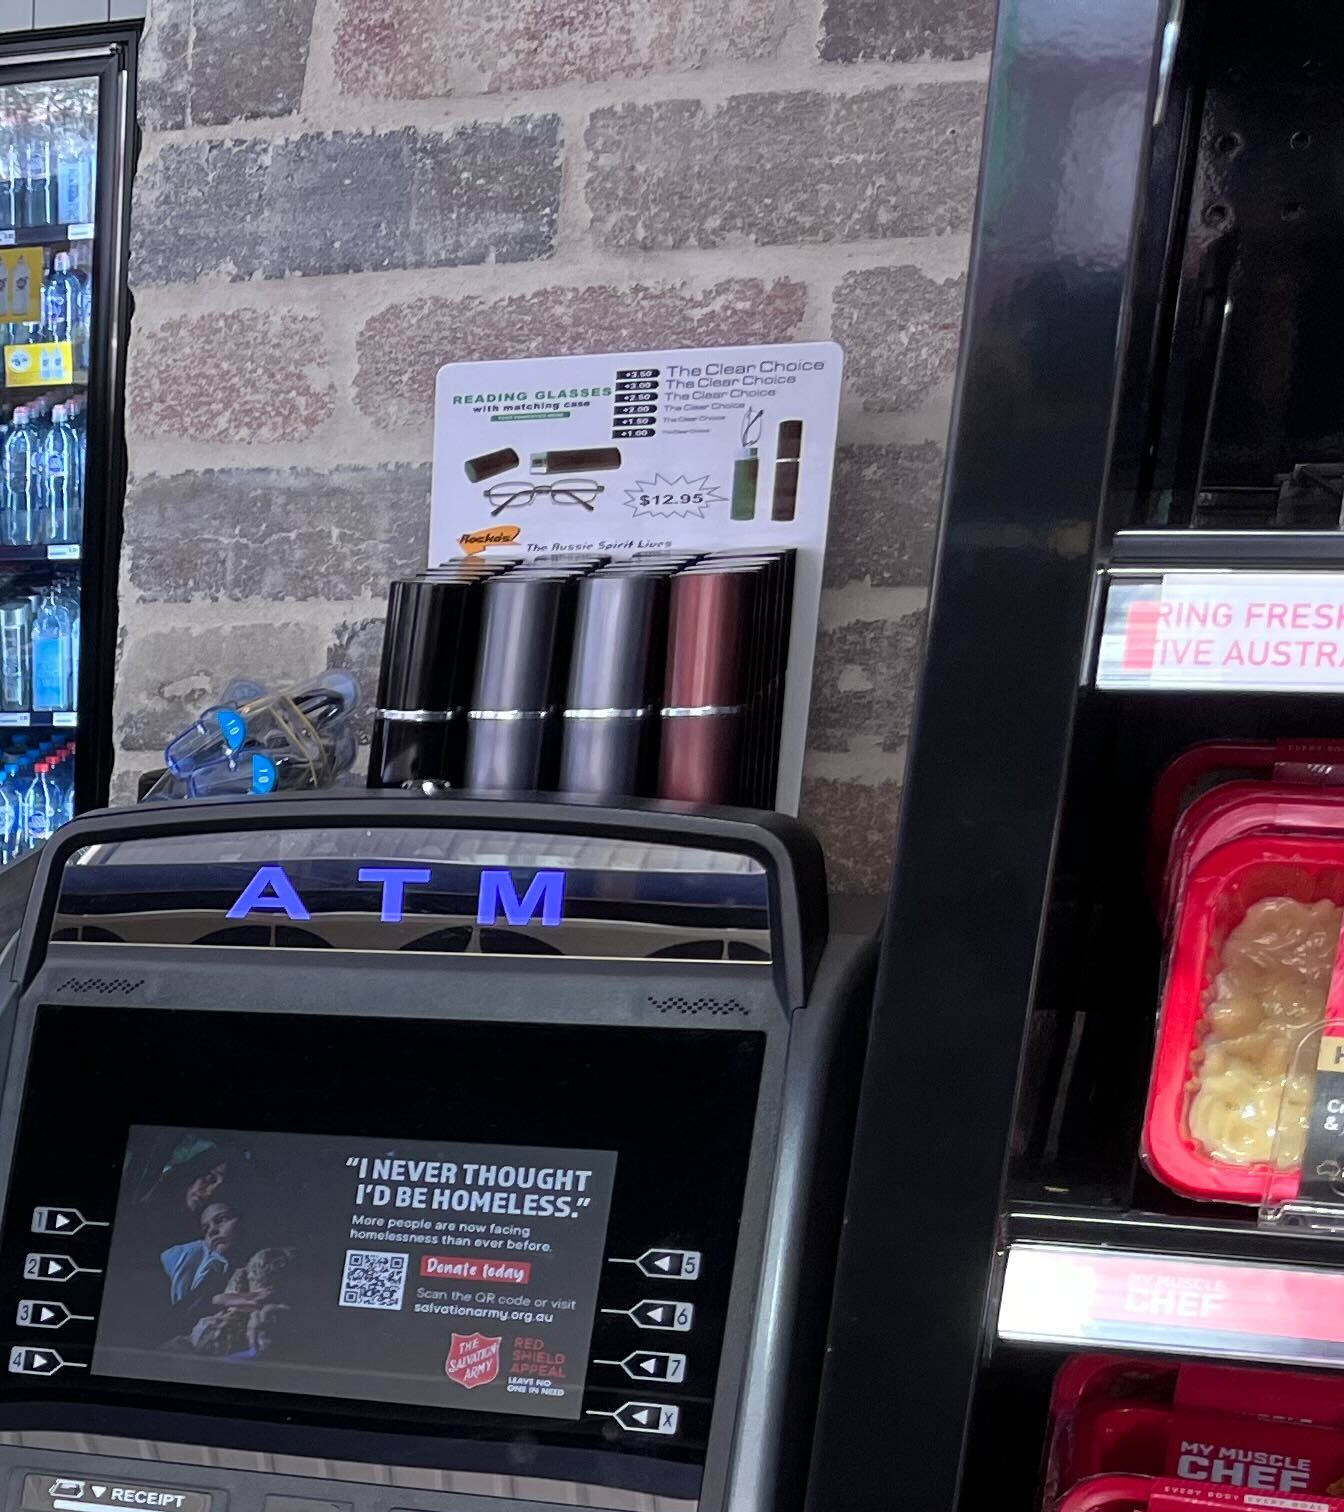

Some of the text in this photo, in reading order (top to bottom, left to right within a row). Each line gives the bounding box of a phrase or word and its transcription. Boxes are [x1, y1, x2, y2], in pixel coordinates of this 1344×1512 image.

[667, 359, 825, 378] The Clear Choice
[665, 375, 797, 390] The Clear Choice
[452, 386, 613, 406] READING GLASSES
[473, 400, 591, 413] with matching case
[639, 493, 704, 507] $12.95
[527, 538, 673, 552] The Aussie Spirit Lives
[225, 864, 567, 927] ATM
[372, 1158, 458, 1185] NEVER
[462, 1163, 593, 1193] THOUGHT
[395, 1186, 429, 1210] BE
[351, 1214, 531, 1239] More people are now facing
[349, 1228, 553, 1254] homelessness than ever before.
[426, 1257, 526, 1284] Donate today
[416, 1287, 577, 1311] Scan the QR code or visit
[414, 1302, 554, 1324] salvationarmy.org.au
[458, 1337, 480, 1355] THE
[514, 1336, 544, 1351] RED
[447, 1342, 501, 1374] SALVATION
[512, 1349, 567, 1365] SHIELD
[462, 1359, 493, 1382] ARMY
[509, 1362, 567, 1378] APPEAL
[110, 1488, 185, 1510] RECEIPT
